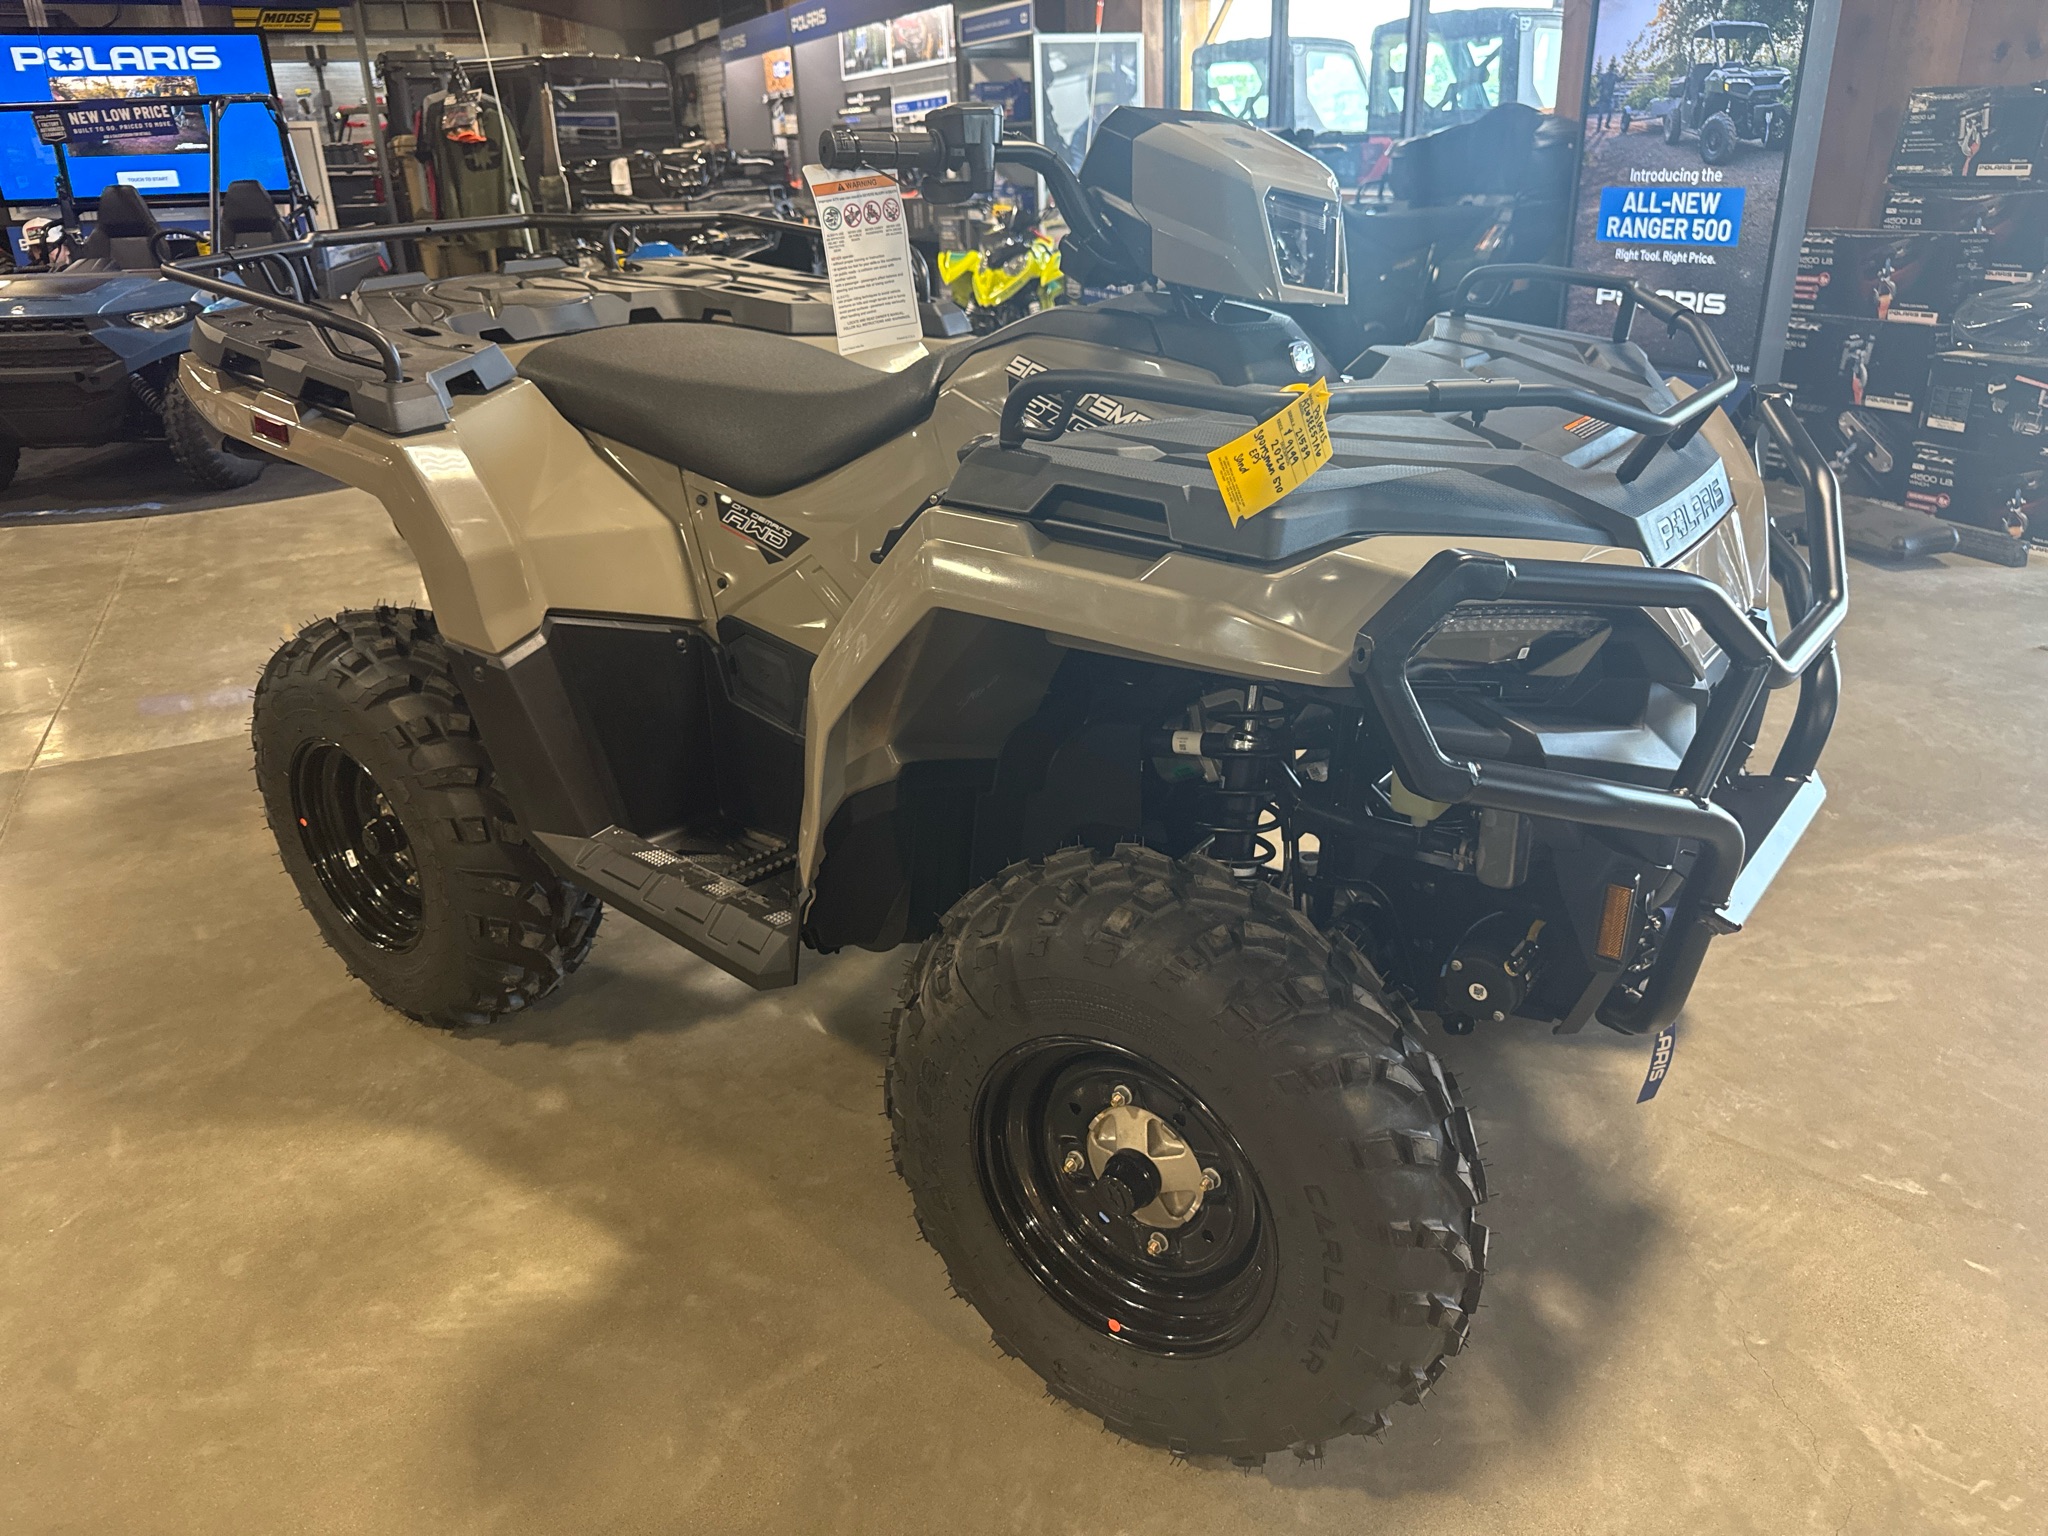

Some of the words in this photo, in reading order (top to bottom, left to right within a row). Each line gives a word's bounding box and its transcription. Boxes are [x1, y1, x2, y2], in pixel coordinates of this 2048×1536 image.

[263, 13, 313, 23] MOOSE
[9, 46, 222, 71] POLARIS
[67, 110, 99, 125] NEW
[101, 106, 131, 123] LOW
[132, 105, 171, 120] PRICE
[73, 127, 94, 135] BUILT
[845, 179, 877, 189] WARNING
[1630, 167, 1699, 186] Introducing
[1701, 168, 1723, 183] the
[1622, 191, 1722, 215] ALL-NEW
[1606, 216, 1689, 240] RANGER
[1692, 218, 1732, 242] 500
[1910, 217, 1922, 226] LB
[1615, 248, 1639, 263] Right
[1640, 250, 1661, 263] Tool.
[1662, 251, 1687, 265] Right
[1688, 252, 1716, 265] Price.
[1596, 287, 1728, 316] PRIS
[1313, 404, 1328, 443] Polaris
[1248, 448, 1262, 465] EPS
[1271, 439, 1286, 471] 2026
[1285, 440, 1299, 466] 9199
[1295, 428, 1311, 460] 21539
[1273, 476, 1284, 494] 570
[1939, 477, 1954, 487] LB
[750, 512, 793, 537] DEMAND
[1657, 478, 1724, 550] POLARIS
[722, 509, 788, 550] AWD
[1649, 1031, 1673, 1082] ARIS
[1301, 1184, 1345, 1375] CARLSTAR
